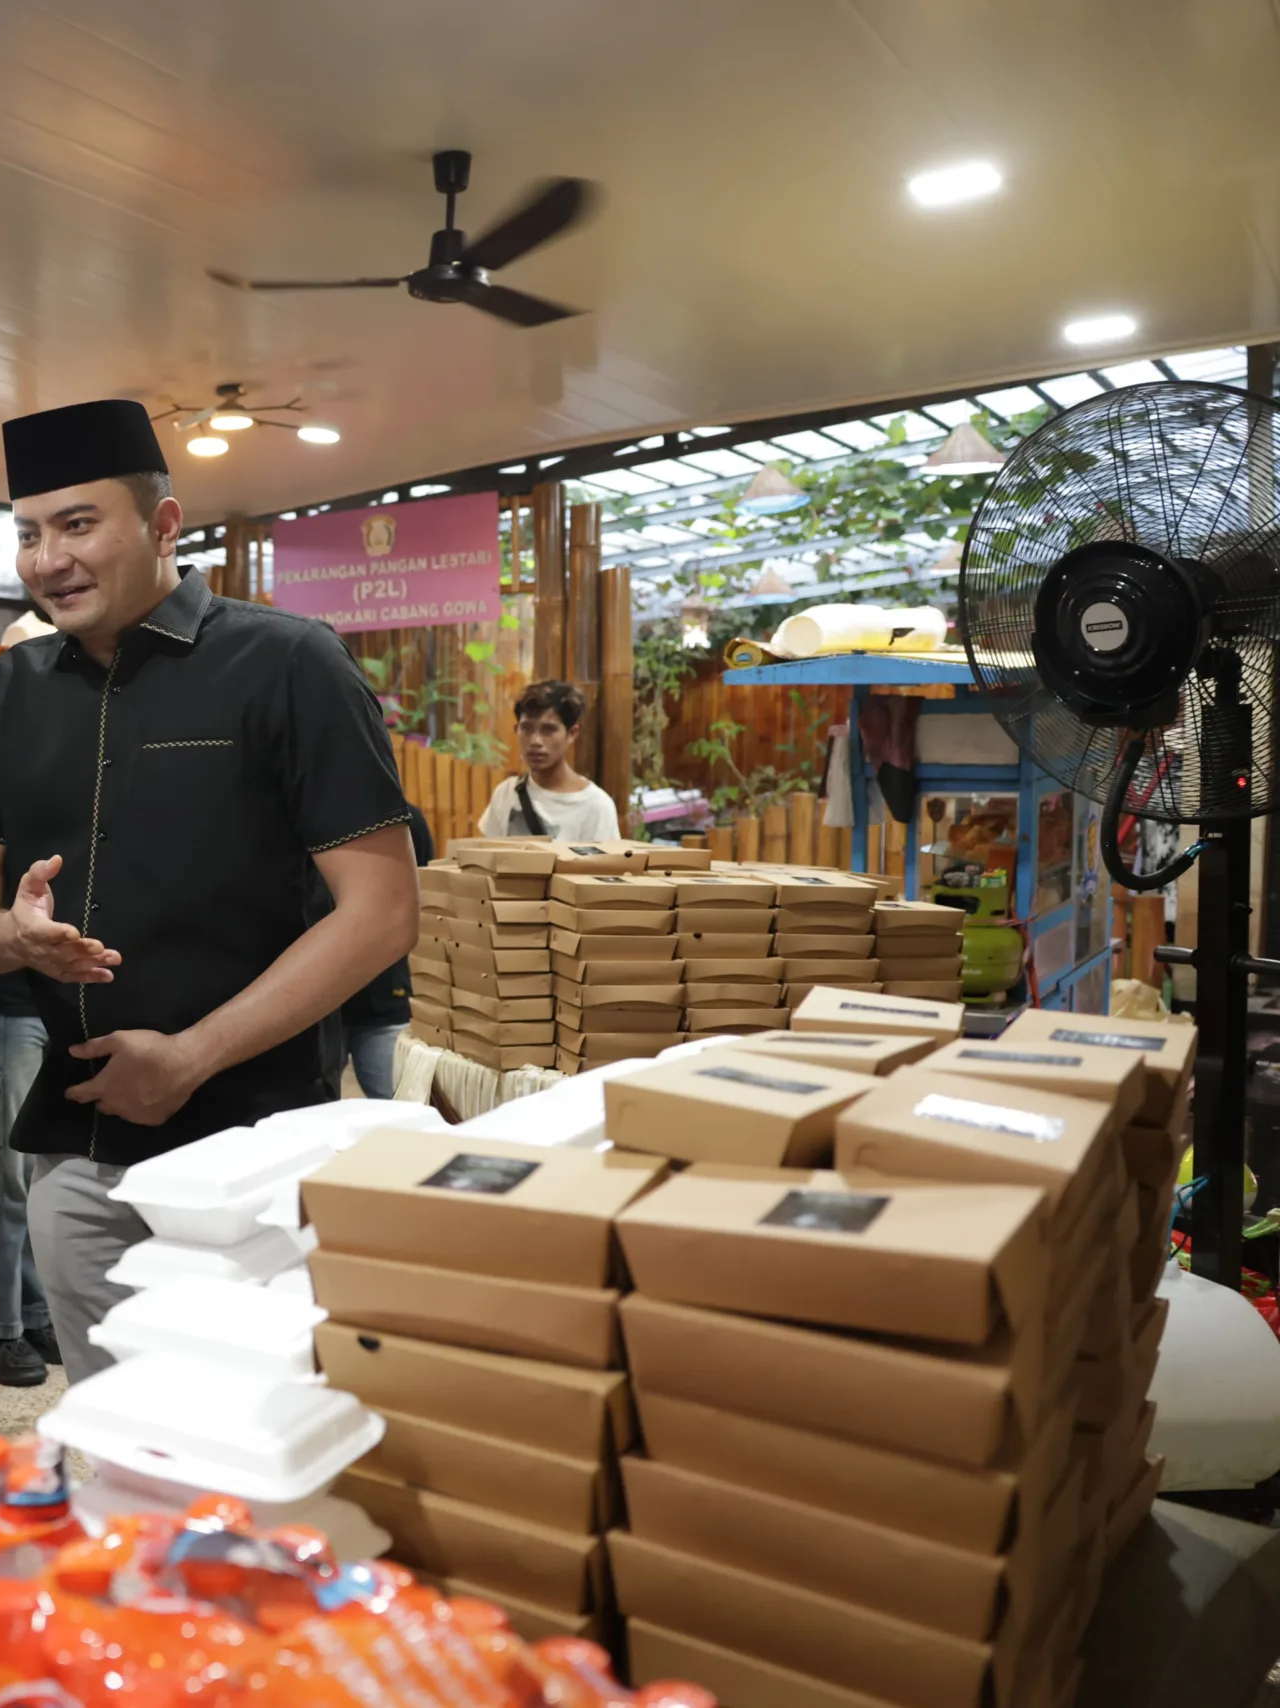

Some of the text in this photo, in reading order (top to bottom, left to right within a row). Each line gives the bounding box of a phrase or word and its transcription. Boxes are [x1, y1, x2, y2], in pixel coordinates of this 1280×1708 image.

[277, 550, 492, 585] PEKARANGAN PANGAN LESTARI
[353, 579, 407, 604] (P2L)
[305, 599, 487, 627] ANGKARI CABANG GOWA
